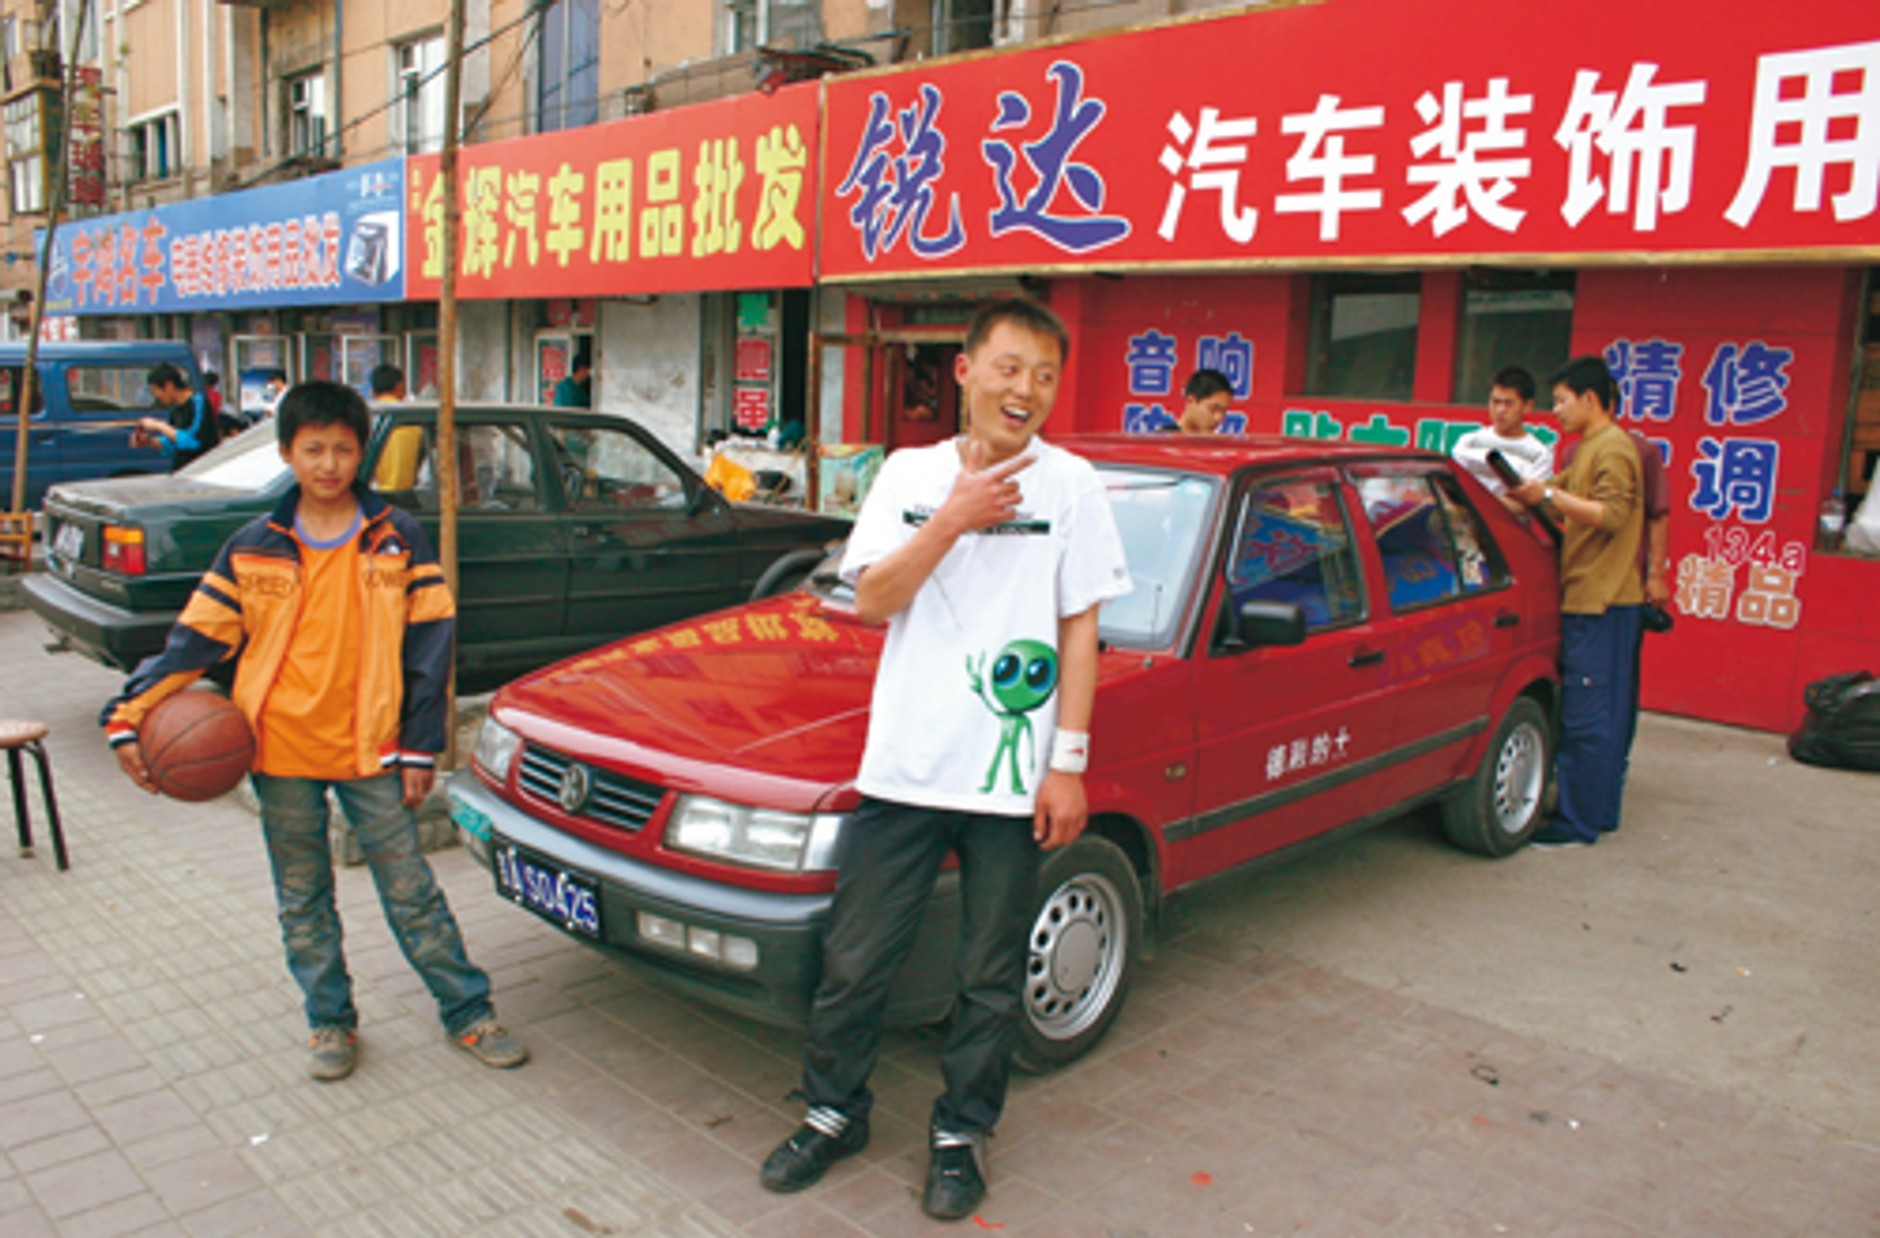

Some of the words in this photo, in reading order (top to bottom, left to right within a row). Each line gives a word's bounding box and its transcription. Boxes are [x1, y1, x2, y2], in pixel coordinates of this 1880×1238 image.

[836, 60, 1132, 261] 锐达
[1157, 40, 1880, 244] 汽车装饰用
[421, 124, 807, 279] 金辉汽车用品批发
[1124, 328, 1253, 400] 音响
[1603, 338, 1794, 426] 精修
[1675, 552, 1802, 629] 精品
